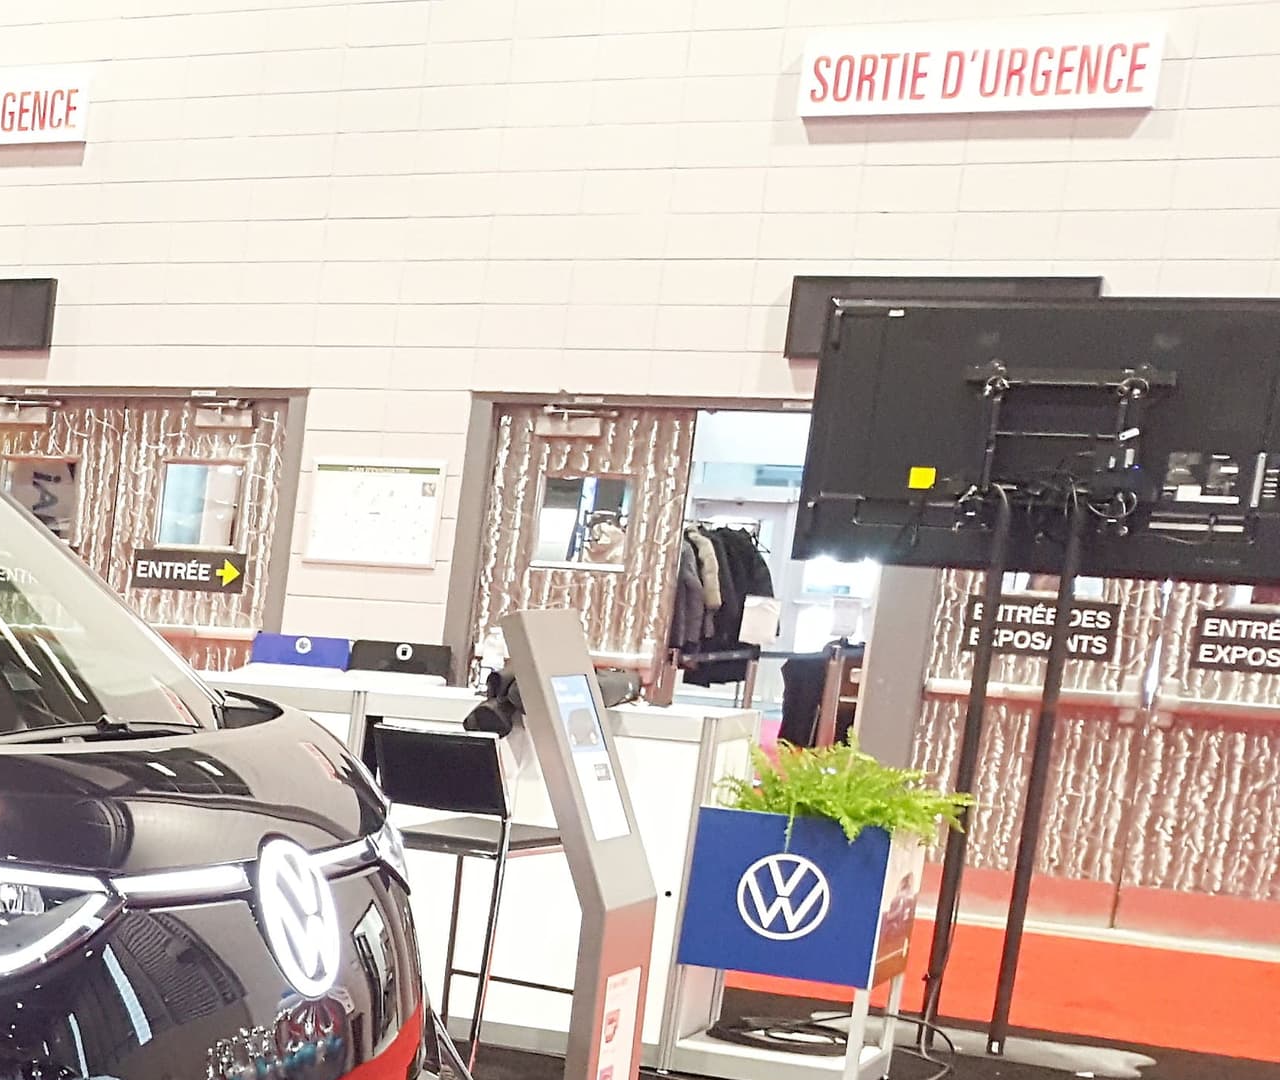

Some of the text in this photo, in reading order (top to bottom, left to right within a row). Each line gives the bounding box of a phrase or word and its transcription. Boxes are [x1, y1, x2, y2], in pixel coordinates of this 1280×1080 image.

[810, 42, 1151, 103] SORTIE D'URGENCE
[136, 559, 212, 581] ENTRÉE
[1203, 617, 1280, 641] ENTRÉ
[1199, 643, 1280, 667] EXPOS
[737, 854, 830, 941] VW
